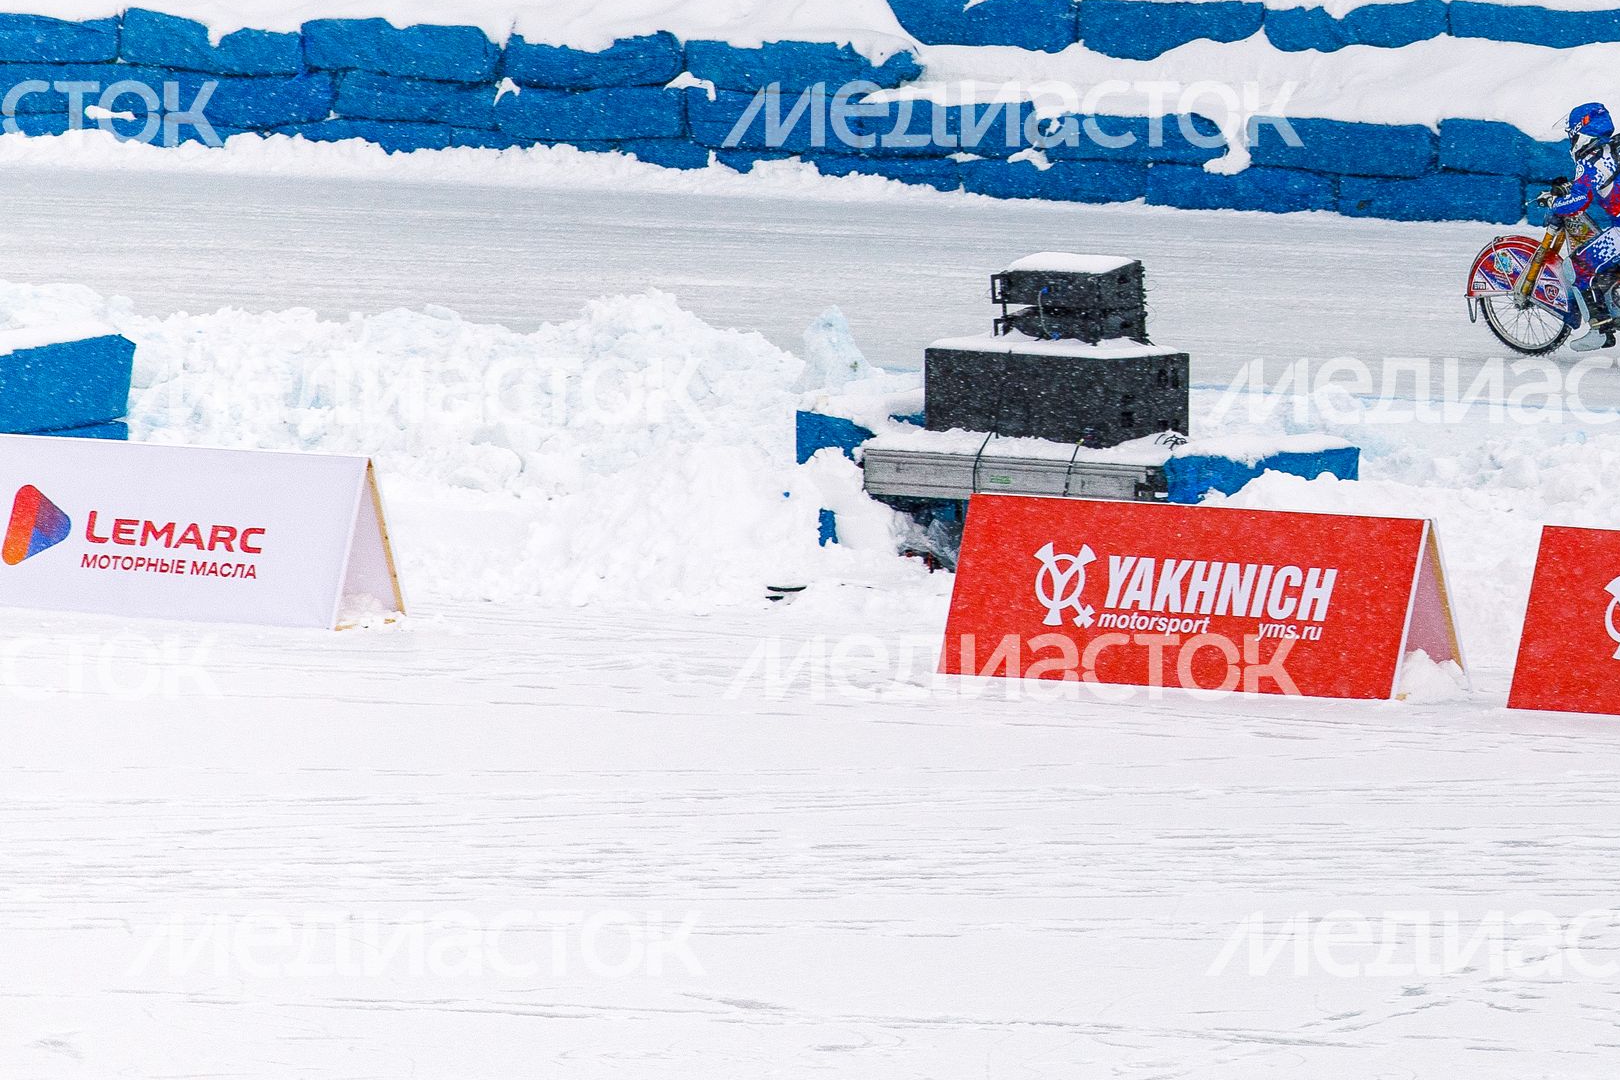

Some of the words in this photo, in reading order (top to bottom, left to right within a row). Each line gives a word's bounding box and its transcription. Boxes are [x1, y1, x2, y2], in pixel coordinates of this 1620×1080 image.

[85, 510, 266, 555] LEMARC
[80, 553, 186, 575] МОТОРНЫЕ
[190, 560, 257, 580] МАСЛА
[1104, 555, 1338, 623] YAKHNICH
[1097, 613, 1211, 638] motorsport
[1254, 620, 1323, 642] yms.ru
